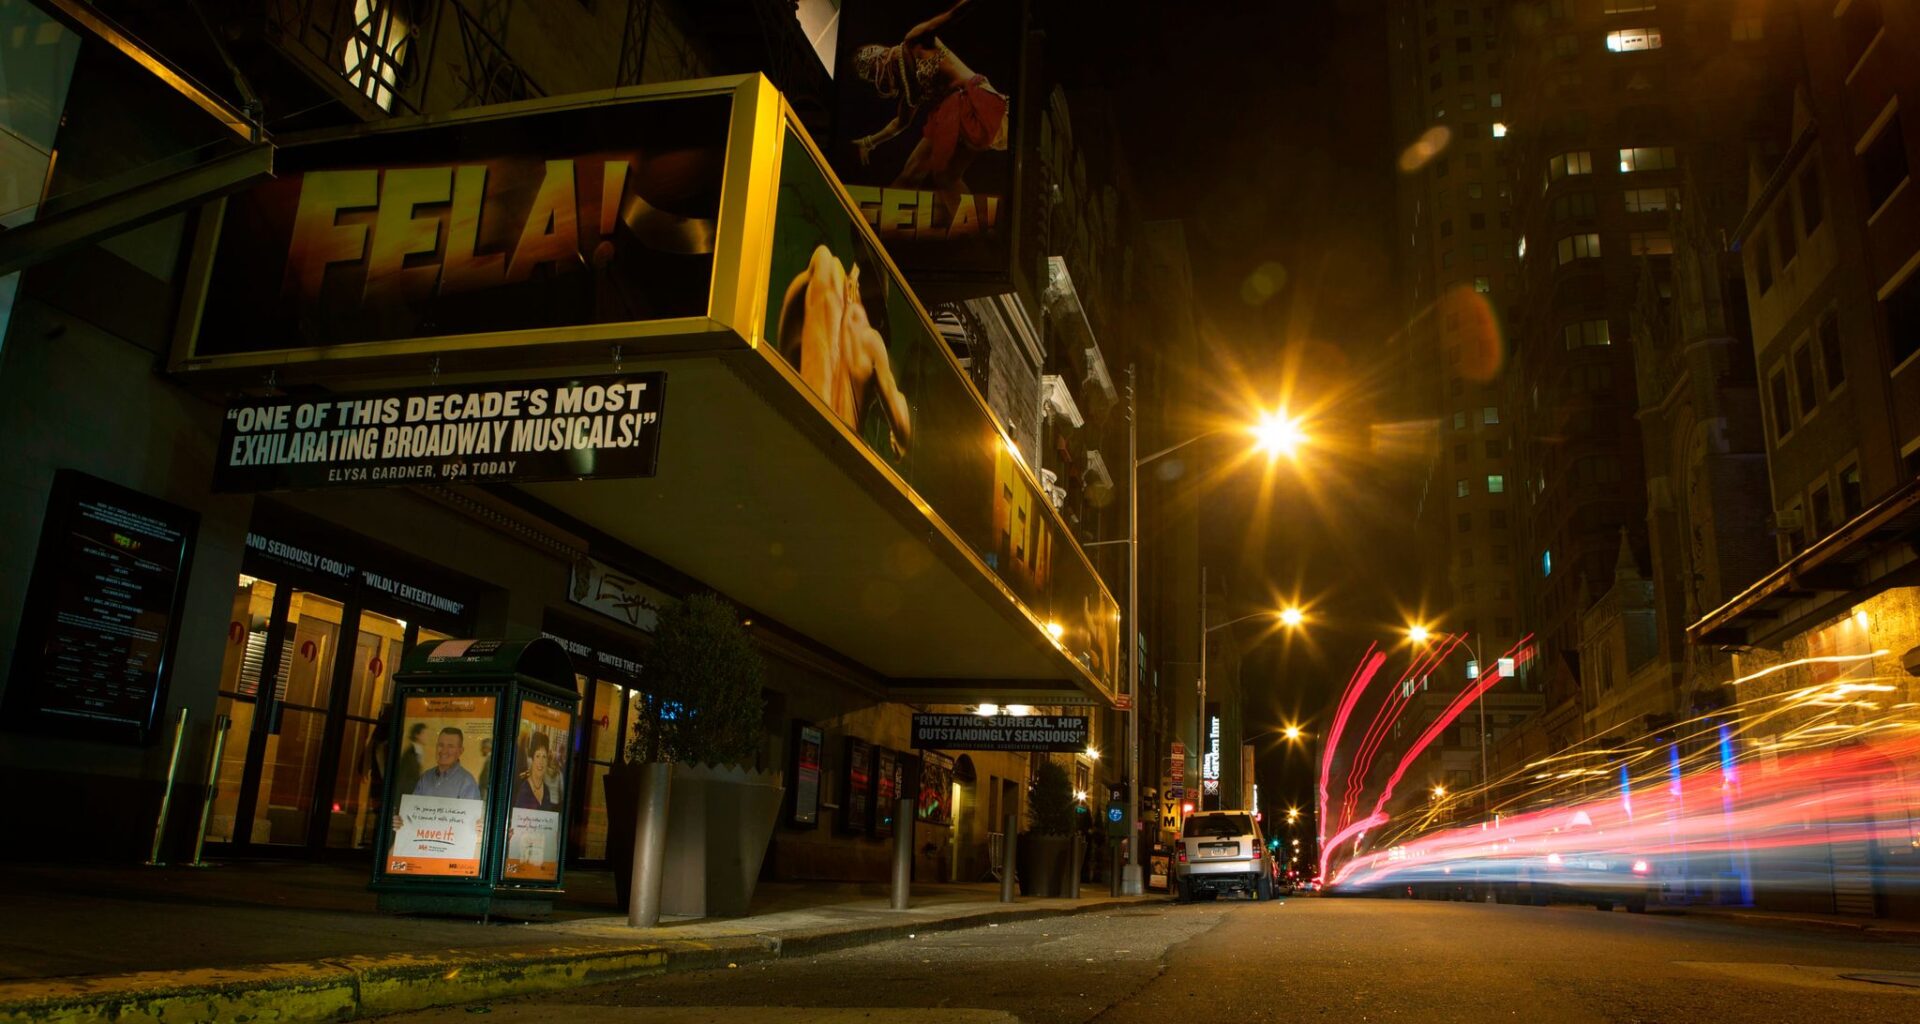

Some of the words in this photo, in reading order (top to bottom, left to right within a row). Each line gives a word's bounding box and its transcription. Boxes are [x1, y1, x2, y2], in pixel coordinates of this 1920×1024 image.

[281, 159, 630, 303] FELA!
[845, 184, 1000, 240] FELA!
[227, 406, 292, 433] “ONE
[295, 402, 332, 429] OF
[336, 397, 401, 427] THIS
[405, 388, 549, 423] DECADE’S
[554, 382, 647, 414] MOST
[229, 427, 379, 466] EXHILARATING
[381, 420, 509, 459] BROADWAY
[511, 412, 657, 453] MUSICALS!”
[328, 468, 367, 482] ELYSA
[372, 465, 437, 480] GARDNER,
[442, 462, 467, 477] USA
[473, 460, 517, 475] TODAY
[246, 531, 267, 551] AND
[267, 539, 321, 568] SERIOUSLY
[914, 716, 985, 728] "RIVETING,
[988, 716, 1054, 729] SURREAL,
[1058, 718, 1083, 730] HIP,
[919, 728, 1012, 741] OUTSTANDINGLY
[1014, 730, 1086, 743] SENSUOUS!"
[1209, 738, 1220, 780] Garden
